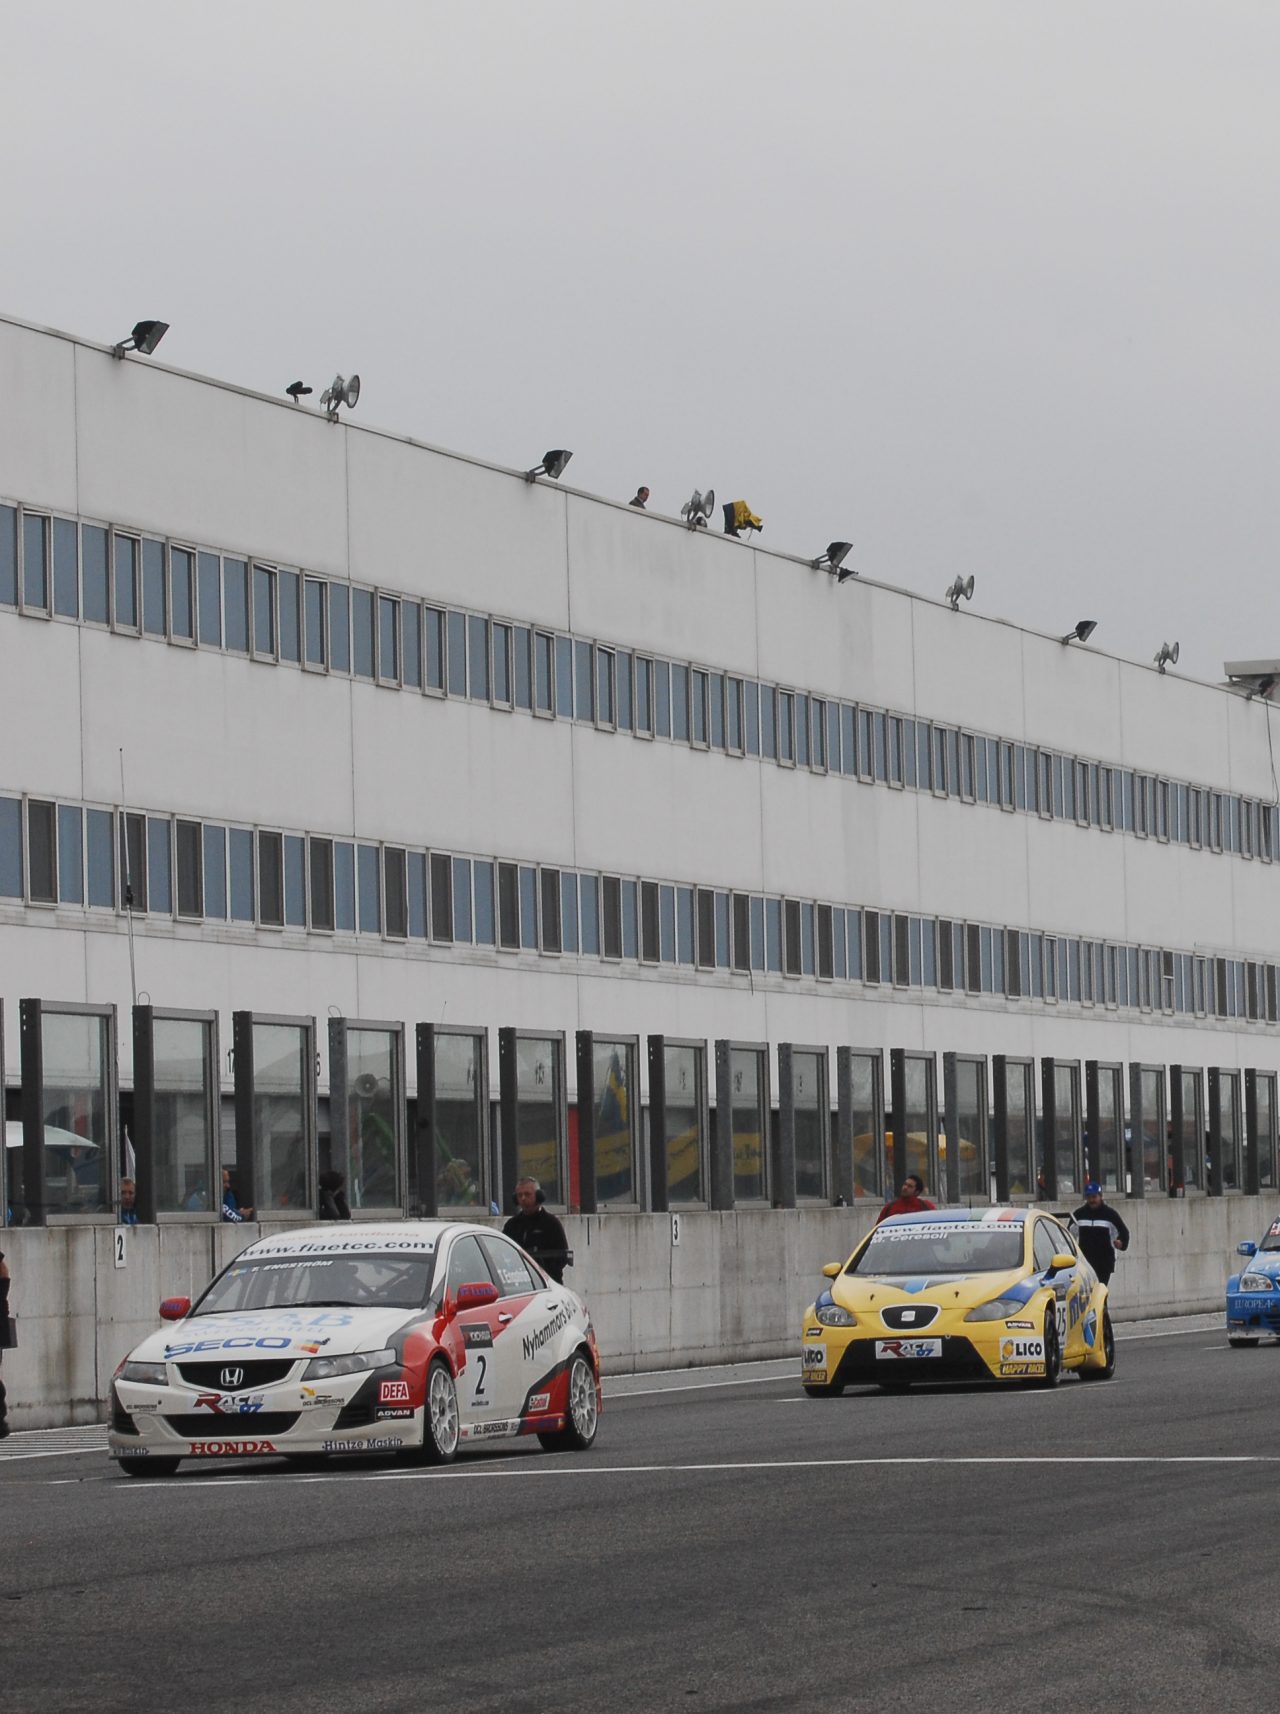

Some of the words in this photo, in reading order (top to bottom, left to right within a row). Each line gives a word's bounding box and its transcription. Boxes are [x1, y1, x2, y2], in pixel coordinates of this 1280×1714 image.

[672, 1220, 679, 1241] 3
[876, 1223, 1024, 1235] www.fiaetcc.com
[890, 1232, 949, 1242] Ceresoli
[116, 1234, 124, 1261] 2
[242, 1241, 434, 1257] www.fiaetcc.com
[263, 1260, 334, 1272] ENGSTRÖM
[521, 1311, 568, 1361] Nyhammars
[164, 1337, 292, 1359] SECO
[881, 1341, 935, 1358] RACE
[1015, 1342, 1043, 1356] LICO
[474, 1354, 487, 1396] 2
[1002, 1365, 1026, 1375] HAPPY
[1027, 1364, 1045, 1374] RACER
[382, 1382, 408, 1400] DEFA
[193, 1392, 264, 1414] RACE
[377, 1409, 411, 1418] ADVAN
[189, 1440, 277, 1455] HONDA
[324, 1439, 364, 1451] Hintze
[366, 1437, 402, 1450] Maskin
